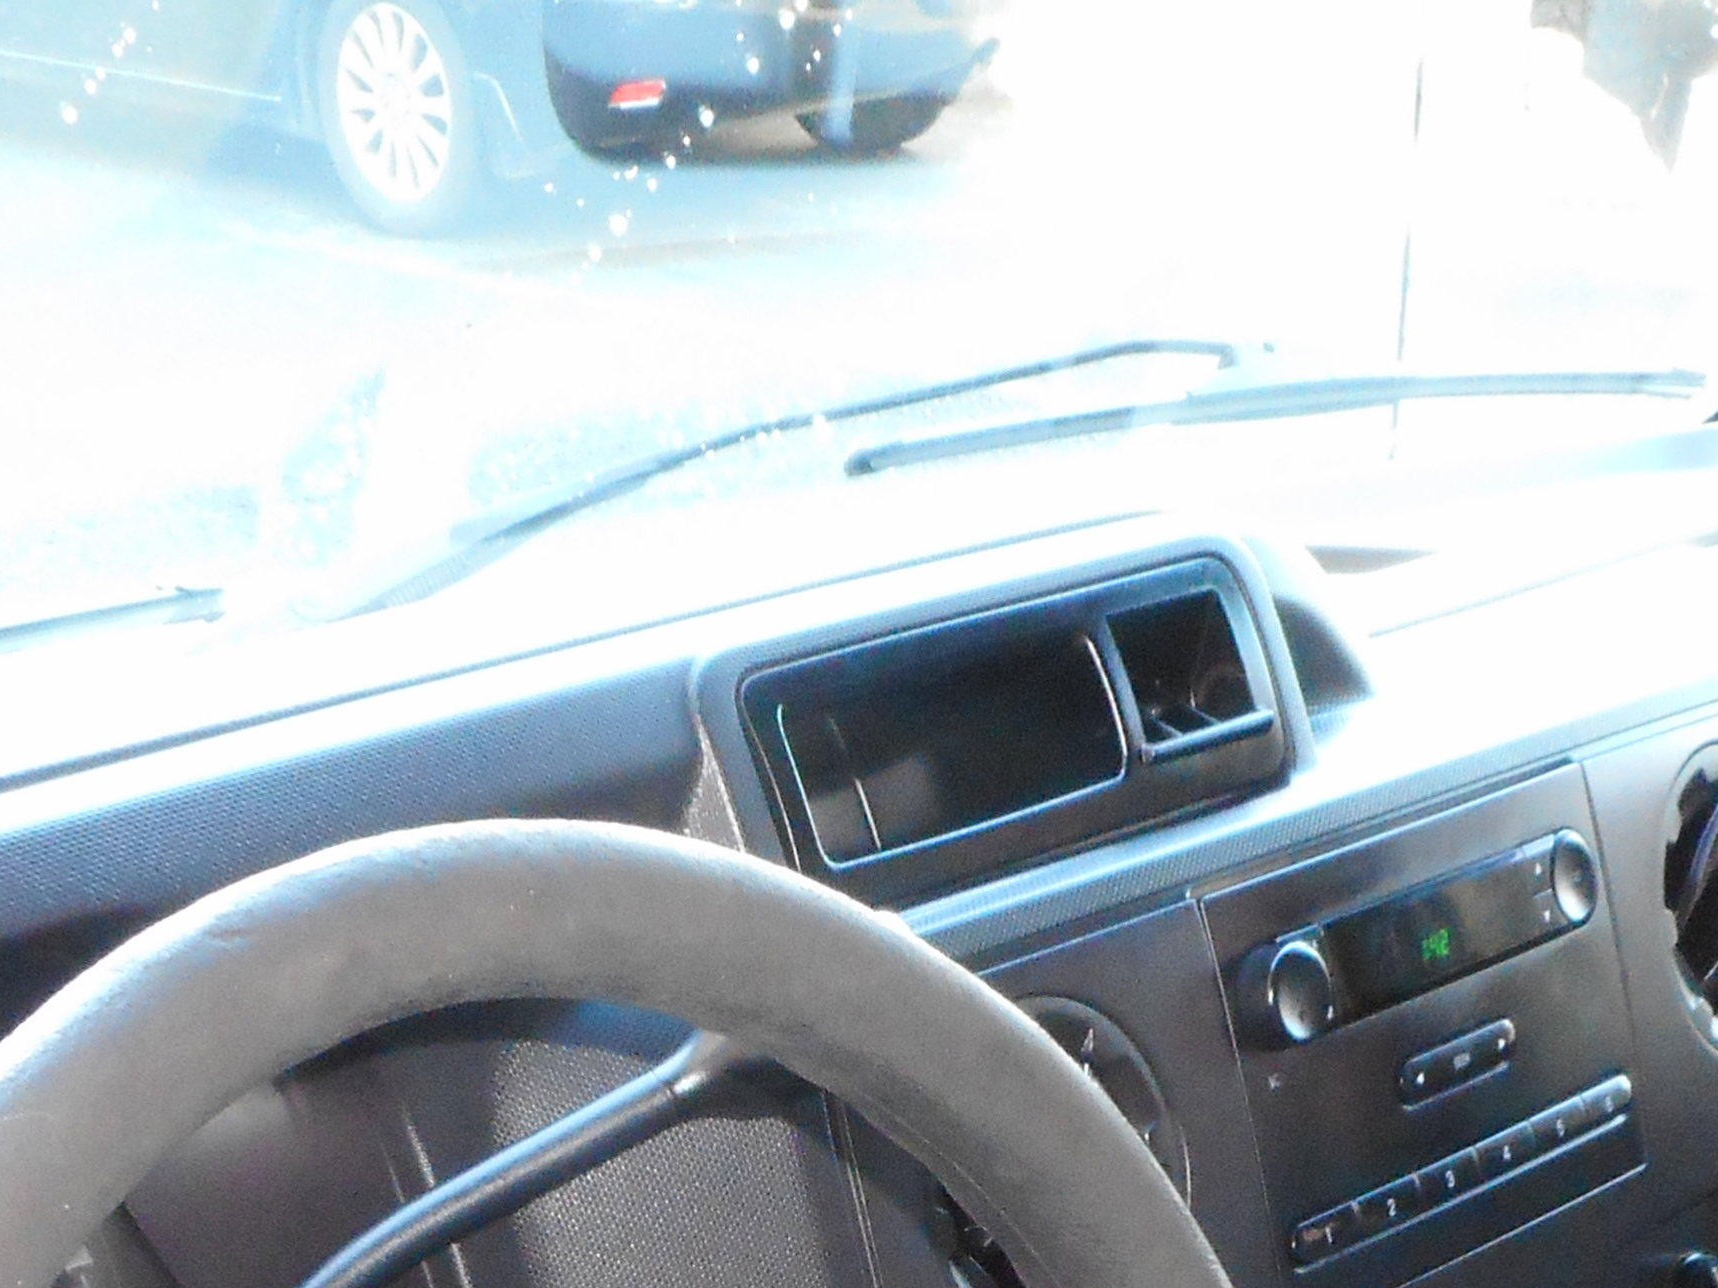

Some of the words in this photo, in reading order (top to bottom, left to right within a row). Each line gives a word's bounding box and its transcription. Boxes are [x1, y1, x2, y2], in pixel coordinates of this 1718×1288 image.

[1387, 1197, 1397, 1216] 2
[1445, 1170, 1455, 1189] 3
[1502, 1145, 1512, 1161] 4
